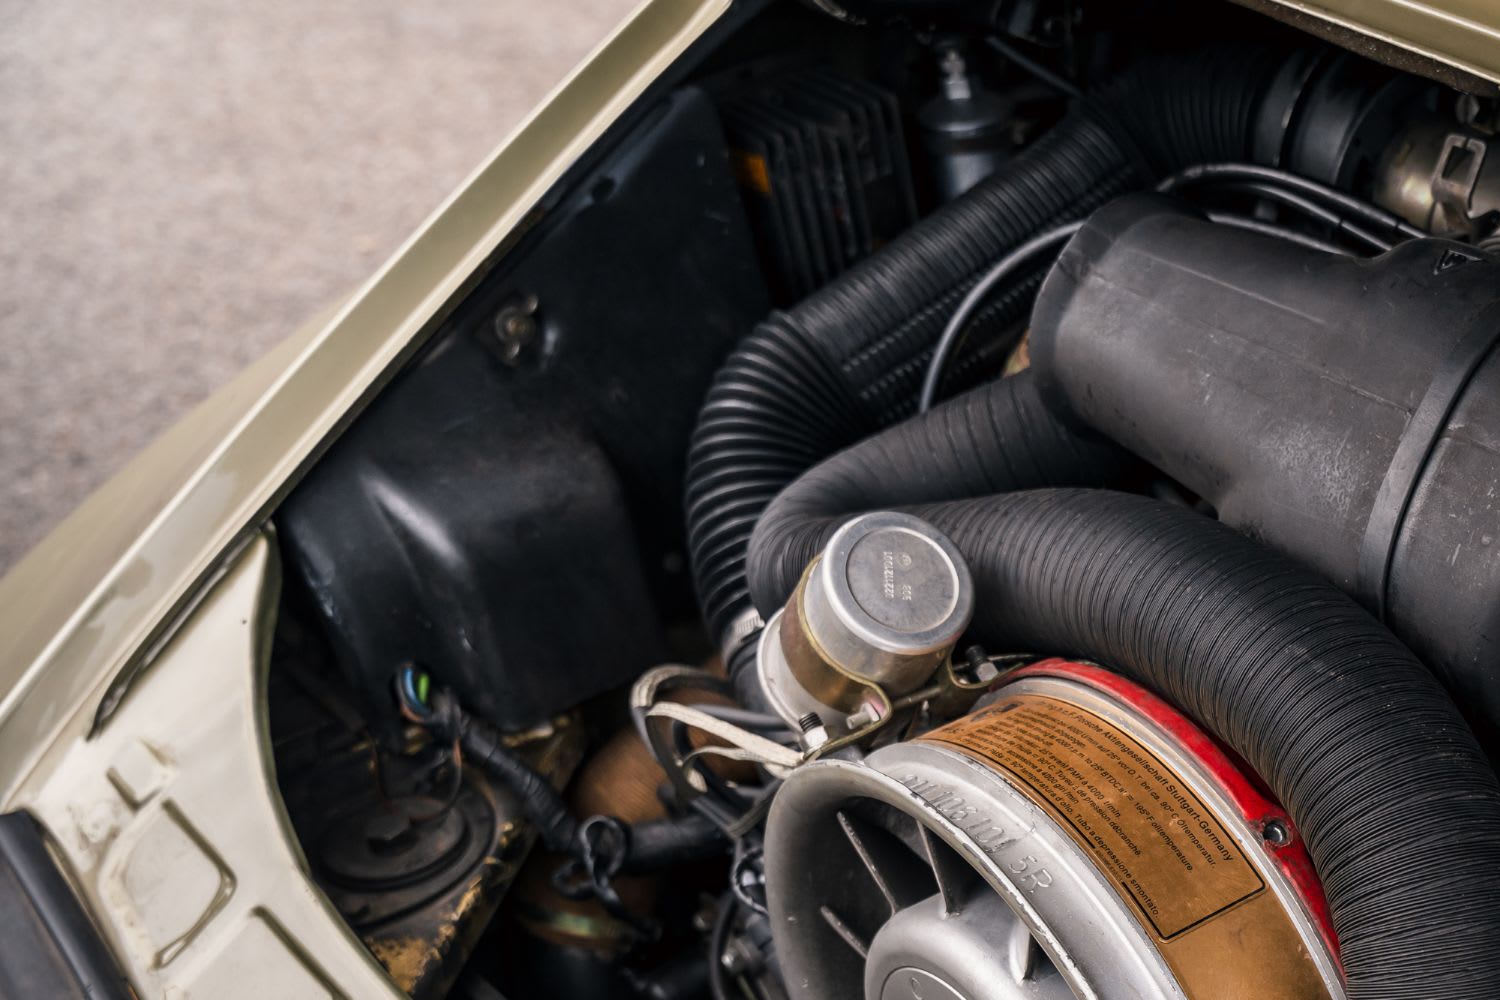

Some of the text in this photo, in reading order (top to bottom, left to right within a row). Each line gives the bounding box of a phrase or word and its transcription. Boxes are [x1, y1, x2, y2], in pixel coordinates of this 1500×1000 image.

[1099, 730, 1170, 786] Aktiengesellschaft
[1163, 784, 1235, 863] Stuttgart-Germany
[1091, 834, 1134, 880] depressione
